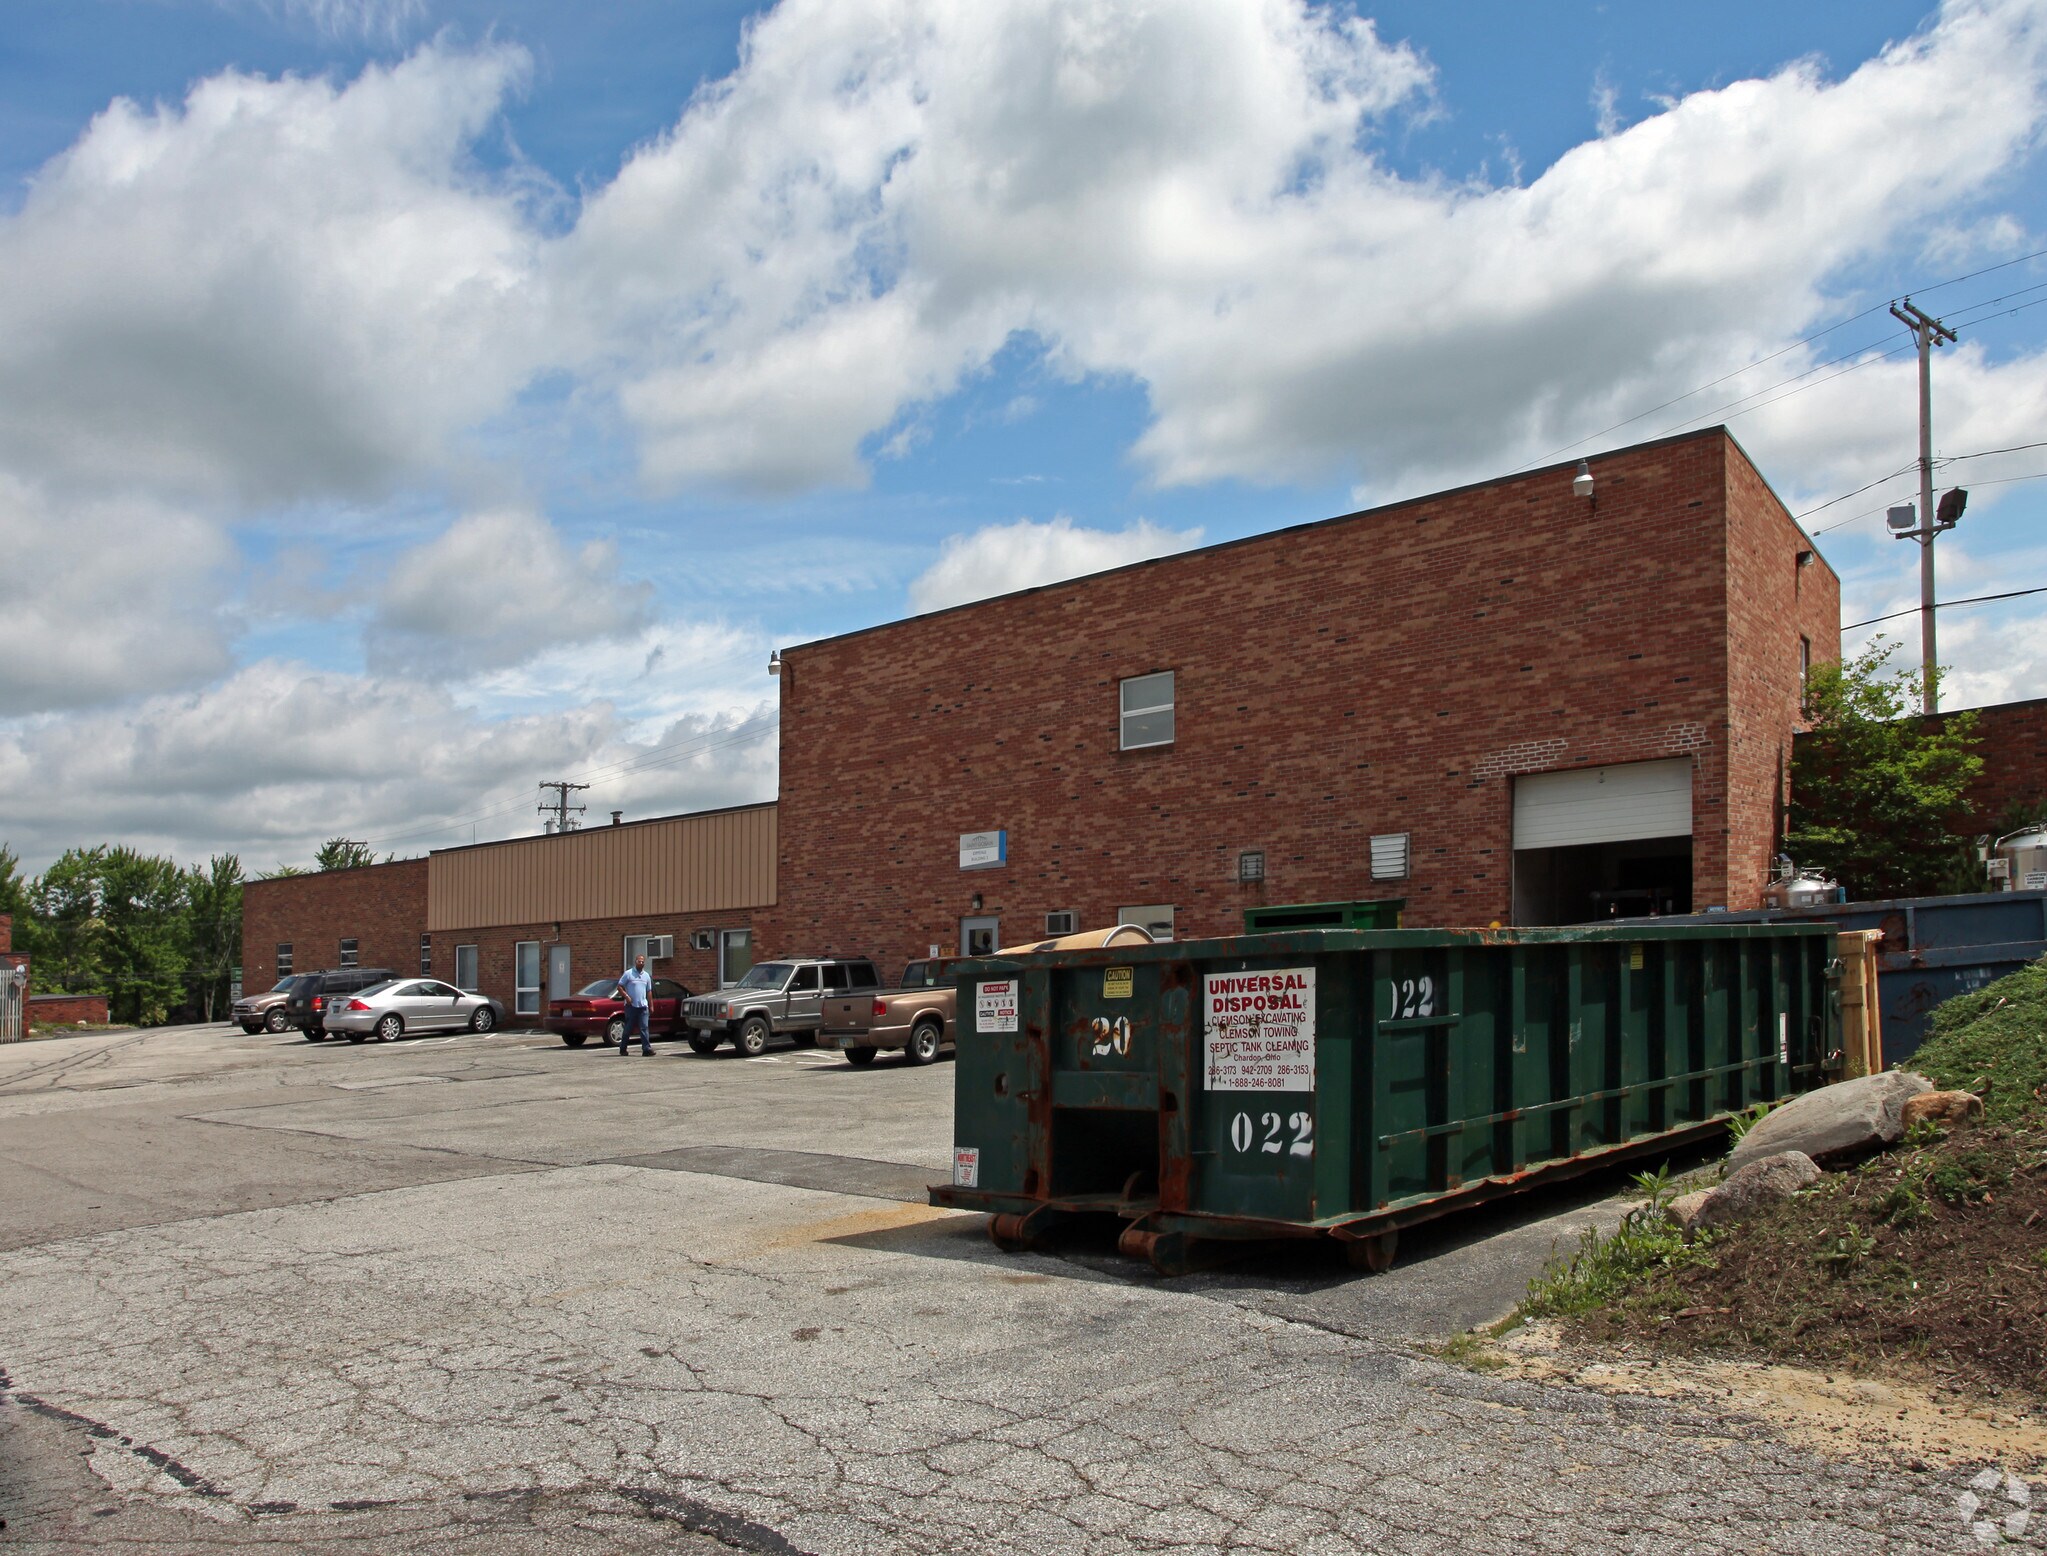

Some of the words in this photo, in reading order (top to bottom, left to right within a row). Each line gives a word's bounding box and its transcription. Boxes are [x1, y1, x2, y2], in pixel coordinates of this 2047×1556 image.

[1107, 970, 1131, 980] CAUTION
[1209, 974, 1307, 995] UNIVERSAL
[1213, 994, 1302, 1013] DISPOSAL
[1211, 1015, 1253, 1027] CLEMSON
[1255, 1012, 1306, 1024] EXCAVATING
[1092, 1016, 1132, 1056] 20
[1220, 1028, 1260, 1039] CLEMSON
[1264, 1026, 1298, 1038] TOWING
[1210, 1042, 1238, 1053] SEPTIC
[1241, 1042, 1262, 1052] TANK
[1266, 1040, 1309, 1052] CLEANING
[1265, 1053, 1281, 1061] Ohio
[1241, 1065, 1273, 1075] 942-2709
[1277, 1065, 1309, 1075] 286-3153
[1229, 1078, 1285, 1088] 1-888-246-8081
[1230, 1111, 1314, 1156] 022
